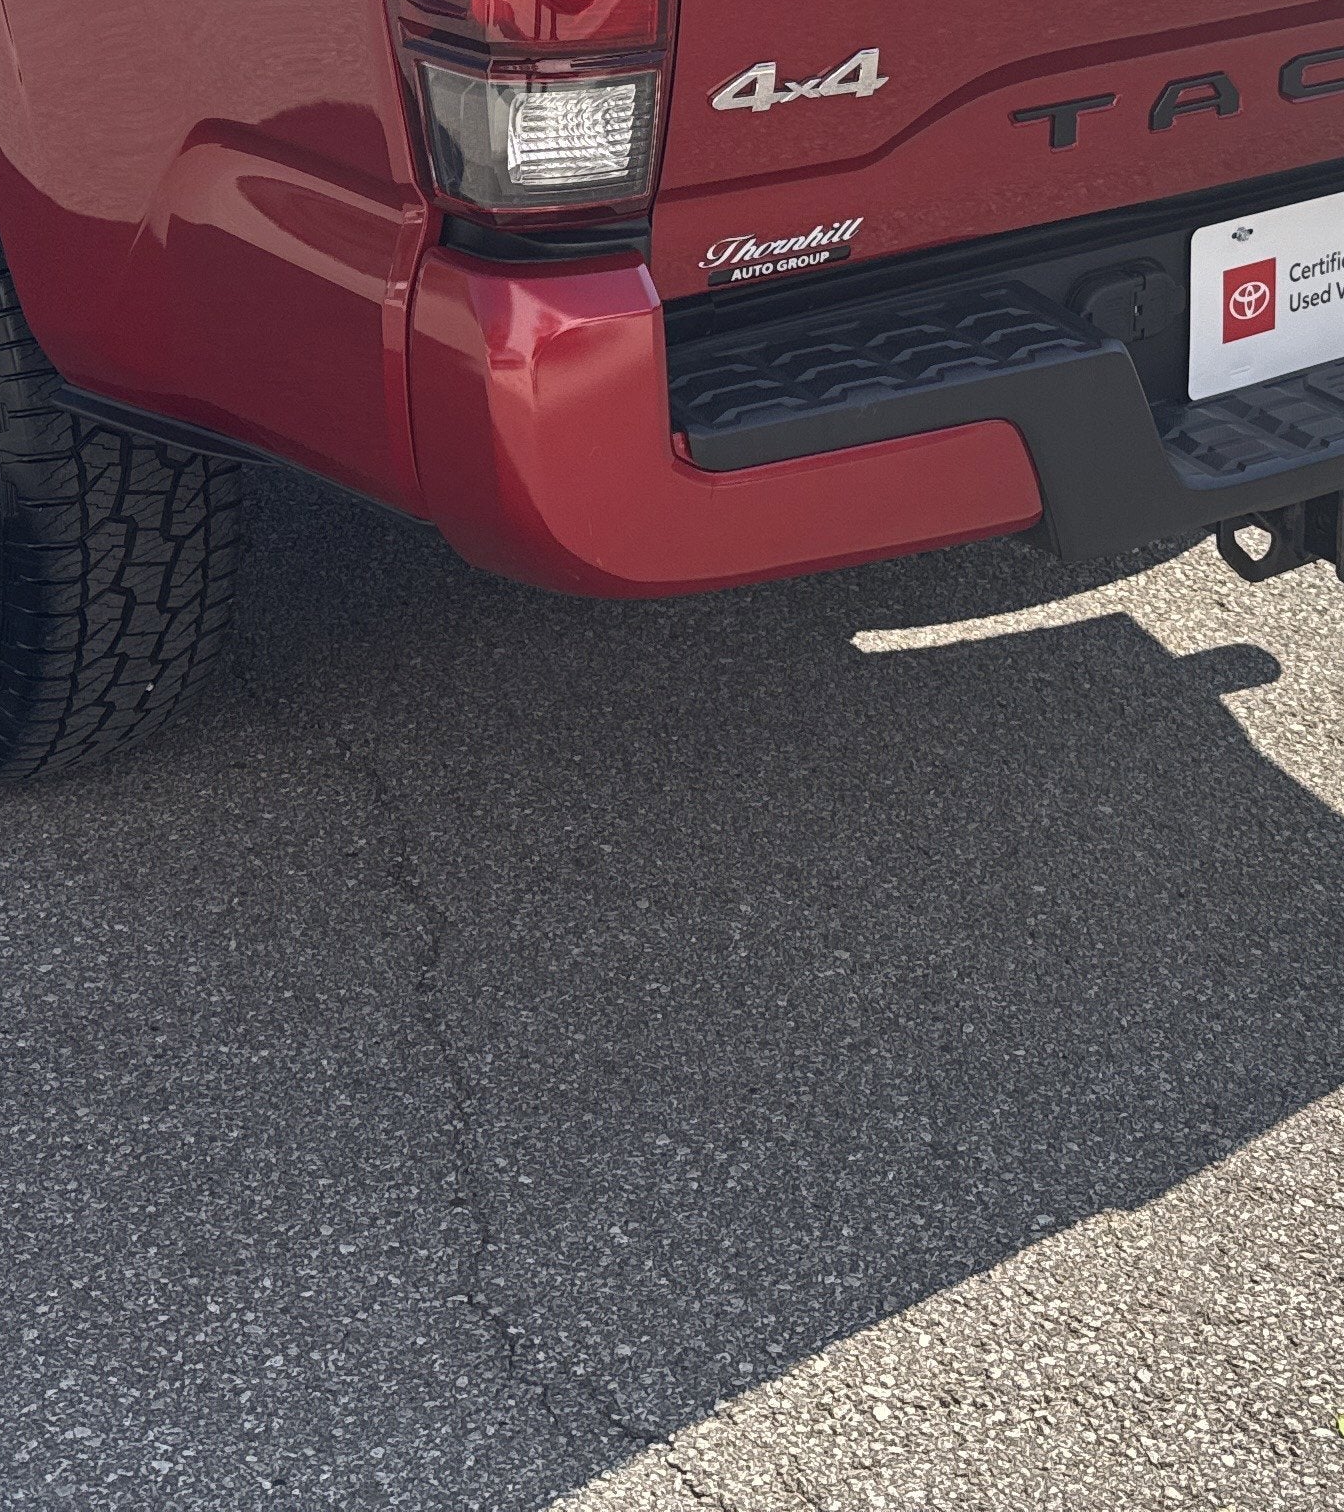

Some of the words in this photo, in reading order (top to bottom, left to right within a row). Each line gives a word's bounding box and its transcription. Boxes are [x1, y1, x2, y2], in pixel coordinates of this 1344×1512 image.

[712, 47, 889, 112] 4x4
[698, 217, 864, 269] Thornhill
[730, 263, 774, 282] AUTO
[776, 250, 830, 273] GROUP
[1289, 283, 1331, 312] Used
